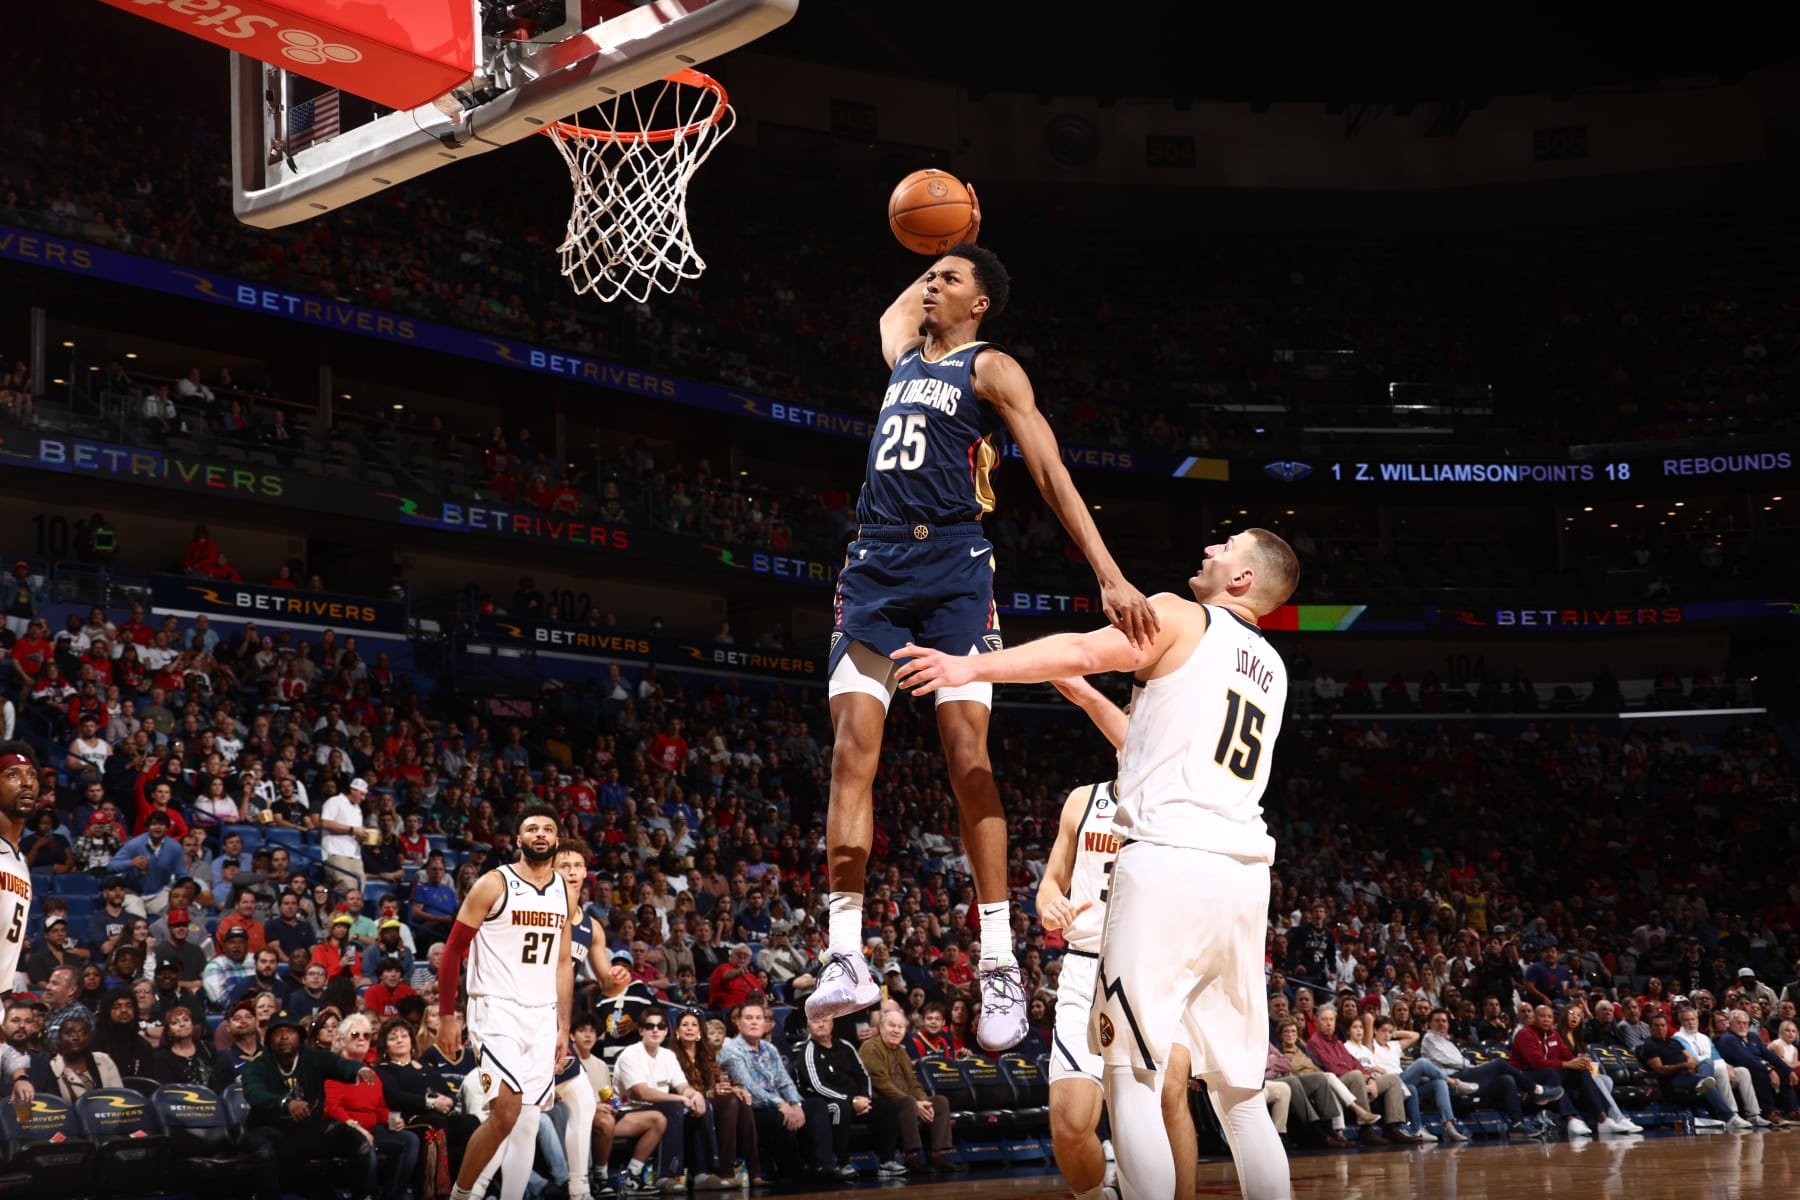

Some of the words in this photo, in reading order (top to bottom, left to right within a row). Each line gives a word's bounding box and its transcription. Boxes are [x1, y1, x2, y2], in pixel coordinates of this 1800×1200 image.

[132, 0, 278, 38] Sta
[236, 284, 415, 340] BETRIVERS
[530, 350, 677, 396] BETRIVERS
[900, 378, 962, 416] ORLEANS
[875, 413, 928, 471] 25
[39, 439, 284, 497] BETRIVERS
[1331, 463, 1341, 481] 1
[1355, 463, 1375, 481] Z.
[1380, 463, 1518, 482] WILLIAMSON
[1604, 463, 1631, 481] 18
[1663, 452, 1792, 477] REBOUNDS
[442, 502, 630, 550] BETRIVERS
[235, 592, 377, 622] BETRIVERS
[1496, 607, 1682, 626] BETRIVERS
[535, 628, 650, 654] BETRIVERS
[713, 649, 816, 674] BETRIVERS
[1236, 647, 1274, 694] JOKIĆ
[1213, 687, 1267, 782] 15
[6, 901, 24, 943] 5
[511, 910, 566, 929] NUGGETS
[521, 931, 556, 966] 27
